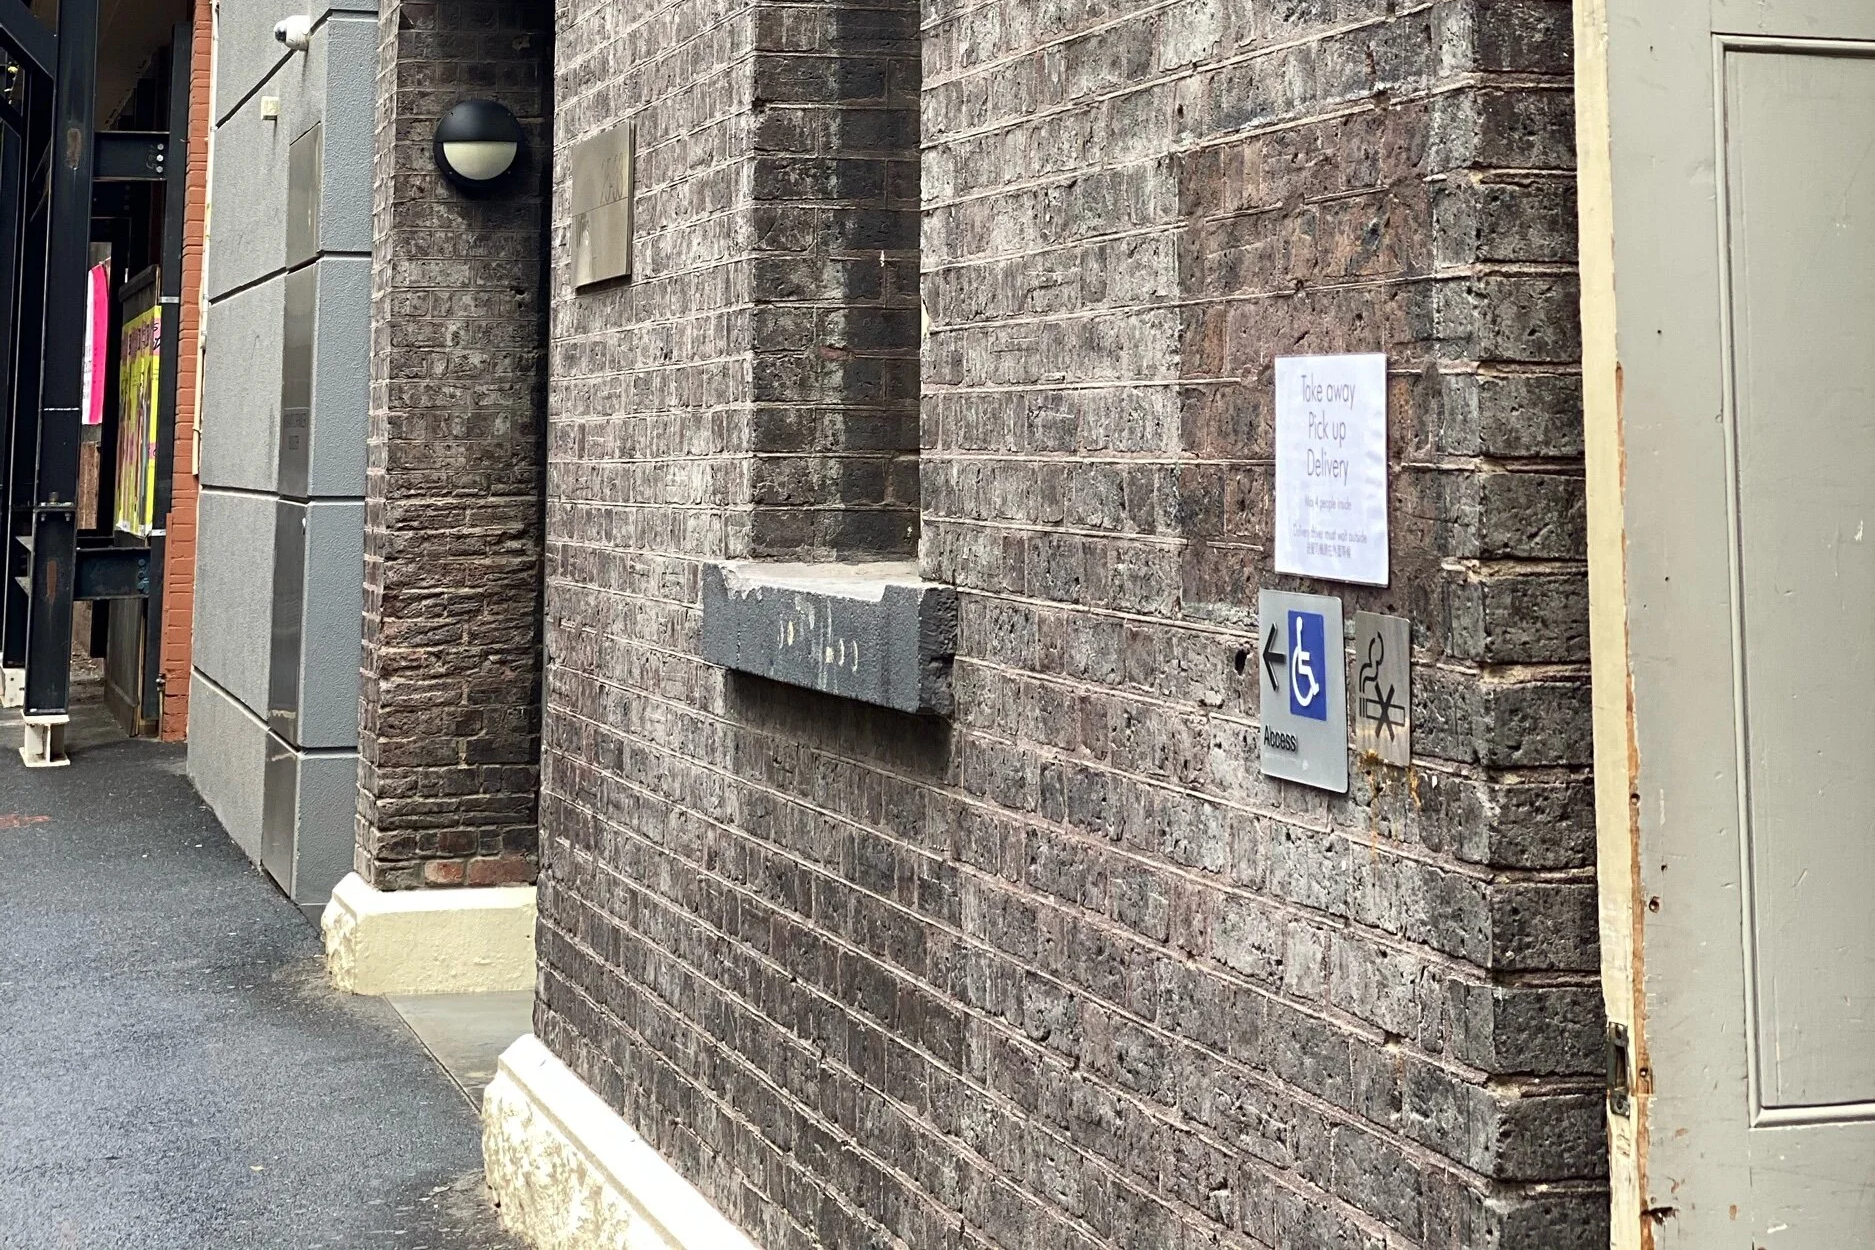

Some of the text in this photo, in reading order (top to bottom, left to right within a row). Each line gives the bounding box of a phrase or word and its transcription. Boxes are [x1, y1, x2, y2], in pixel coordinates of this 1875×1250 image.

[1301, 374, 1356, 410] Take away
[1308, 410, 1347, 447] Pick up
[1306, 446, 1349, 486] Delivery
[1319, 495, 1336, 512] people
[1325, 529, 1336, 540] must
[1349, 529, 1368, 544] outside
[1263, 724, 1298, 753] Access
